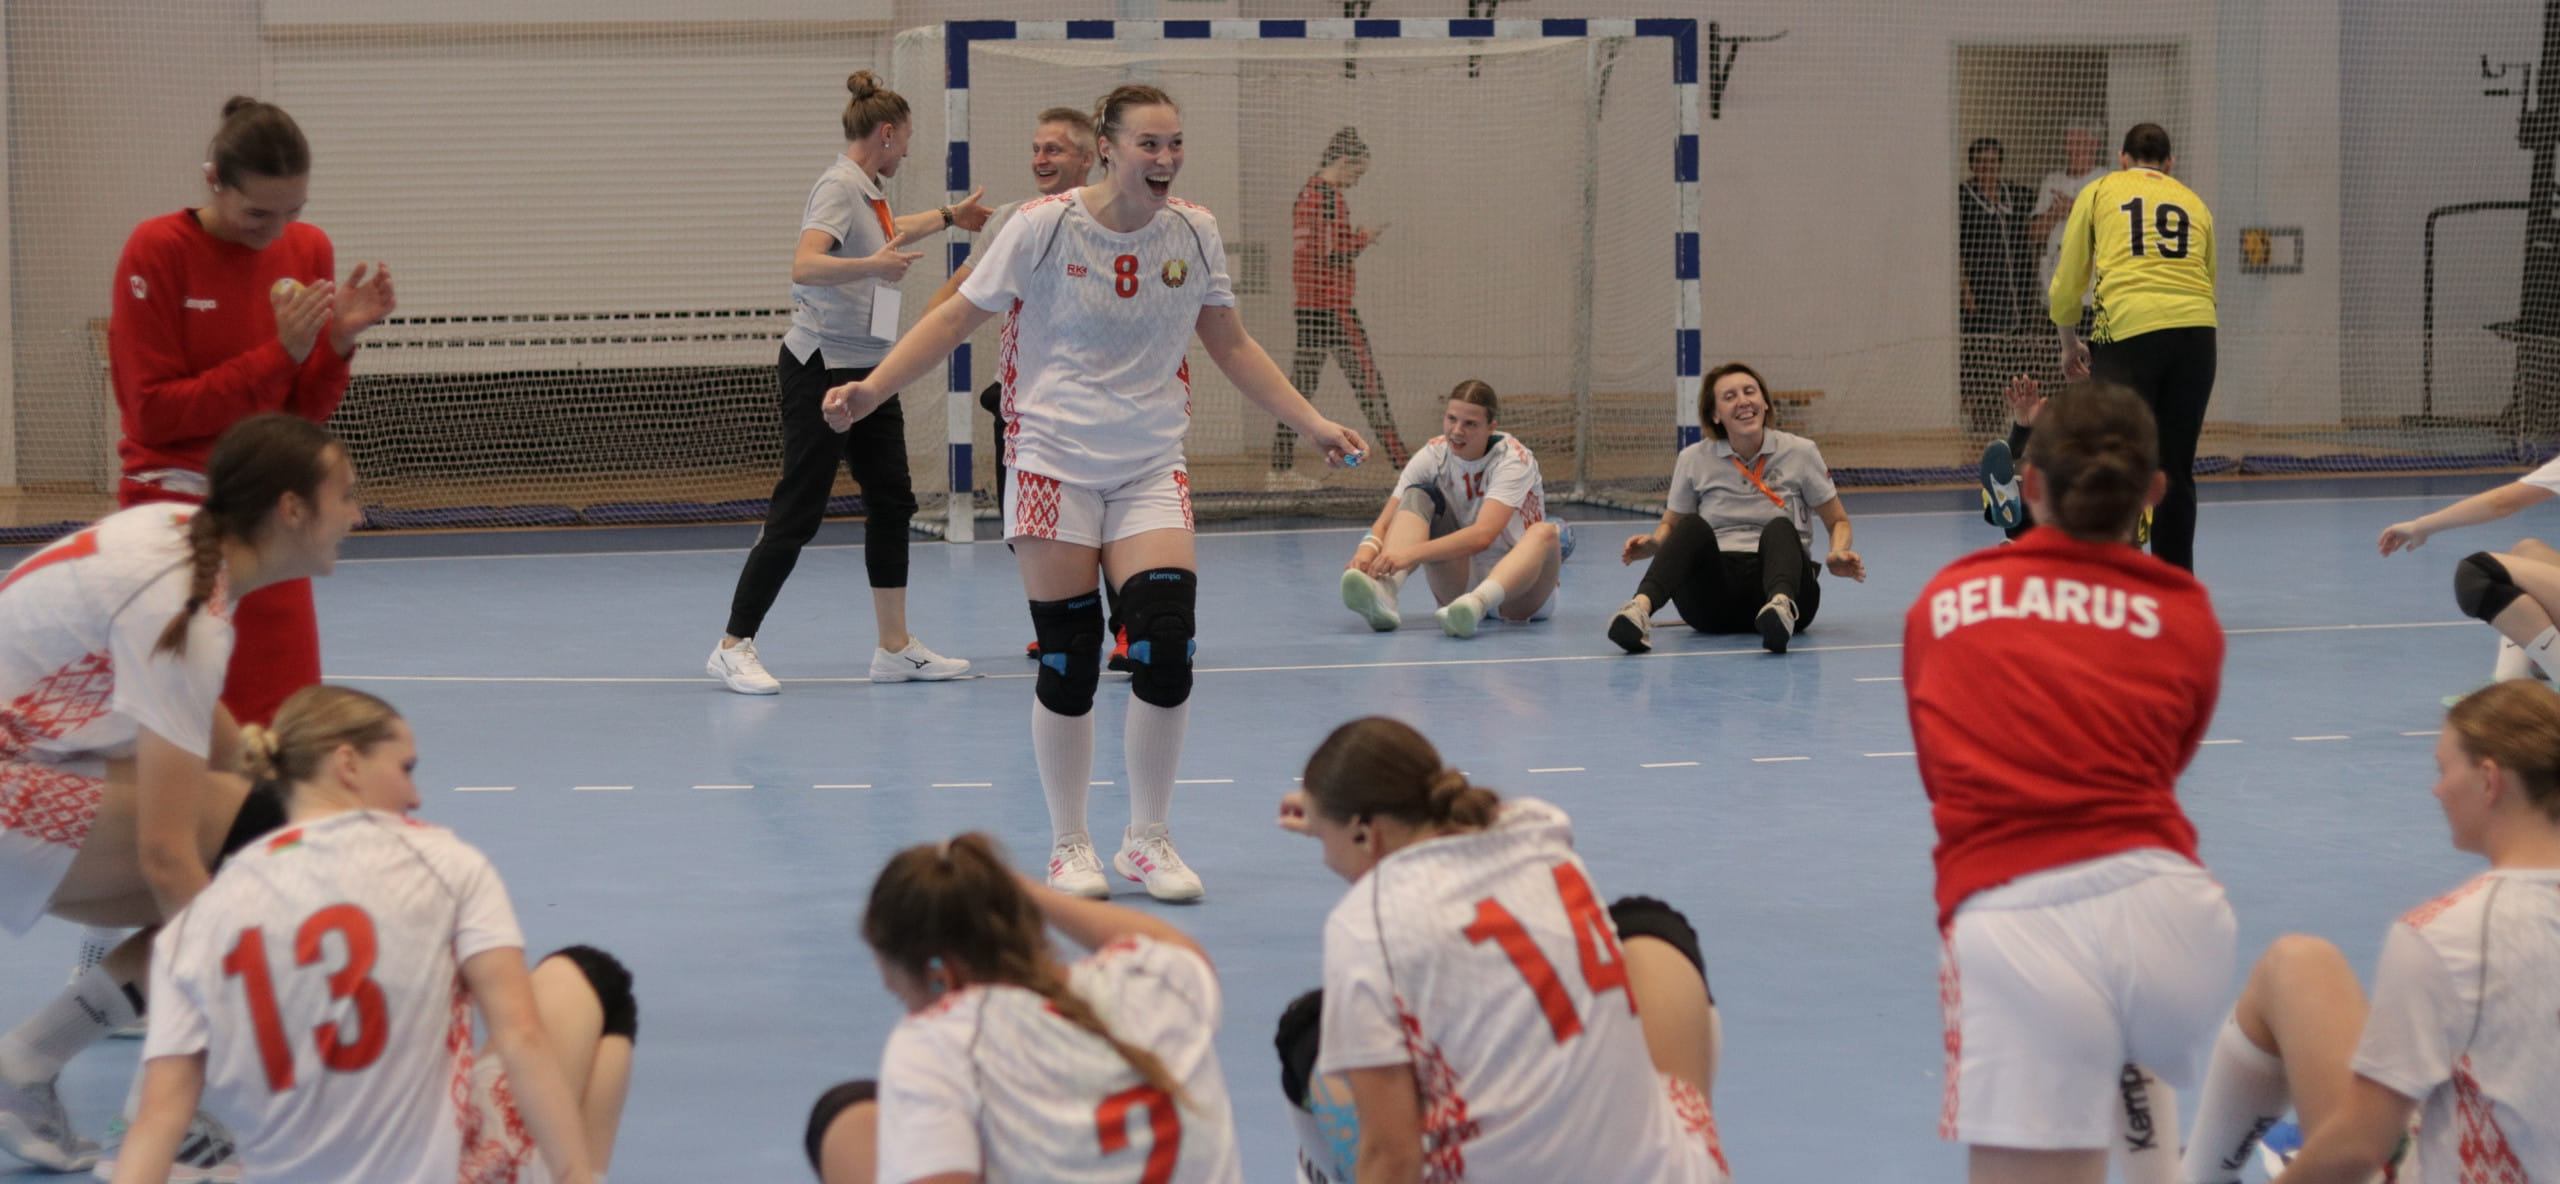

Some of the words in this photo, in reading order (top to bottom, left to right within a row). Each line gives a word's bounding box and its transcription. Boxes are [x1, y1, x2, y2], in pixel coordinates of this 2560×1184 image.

[2120, 197, 2190, 259] 19
[1114, 254, 1139, 298] 8
[1931, 584, 2161, 639] BELARUS
[1462, 861, 1638, 1046] 14
[222, 903, 389, 1094] 13
[2120, 1063, 2158, 1152] Kemp
